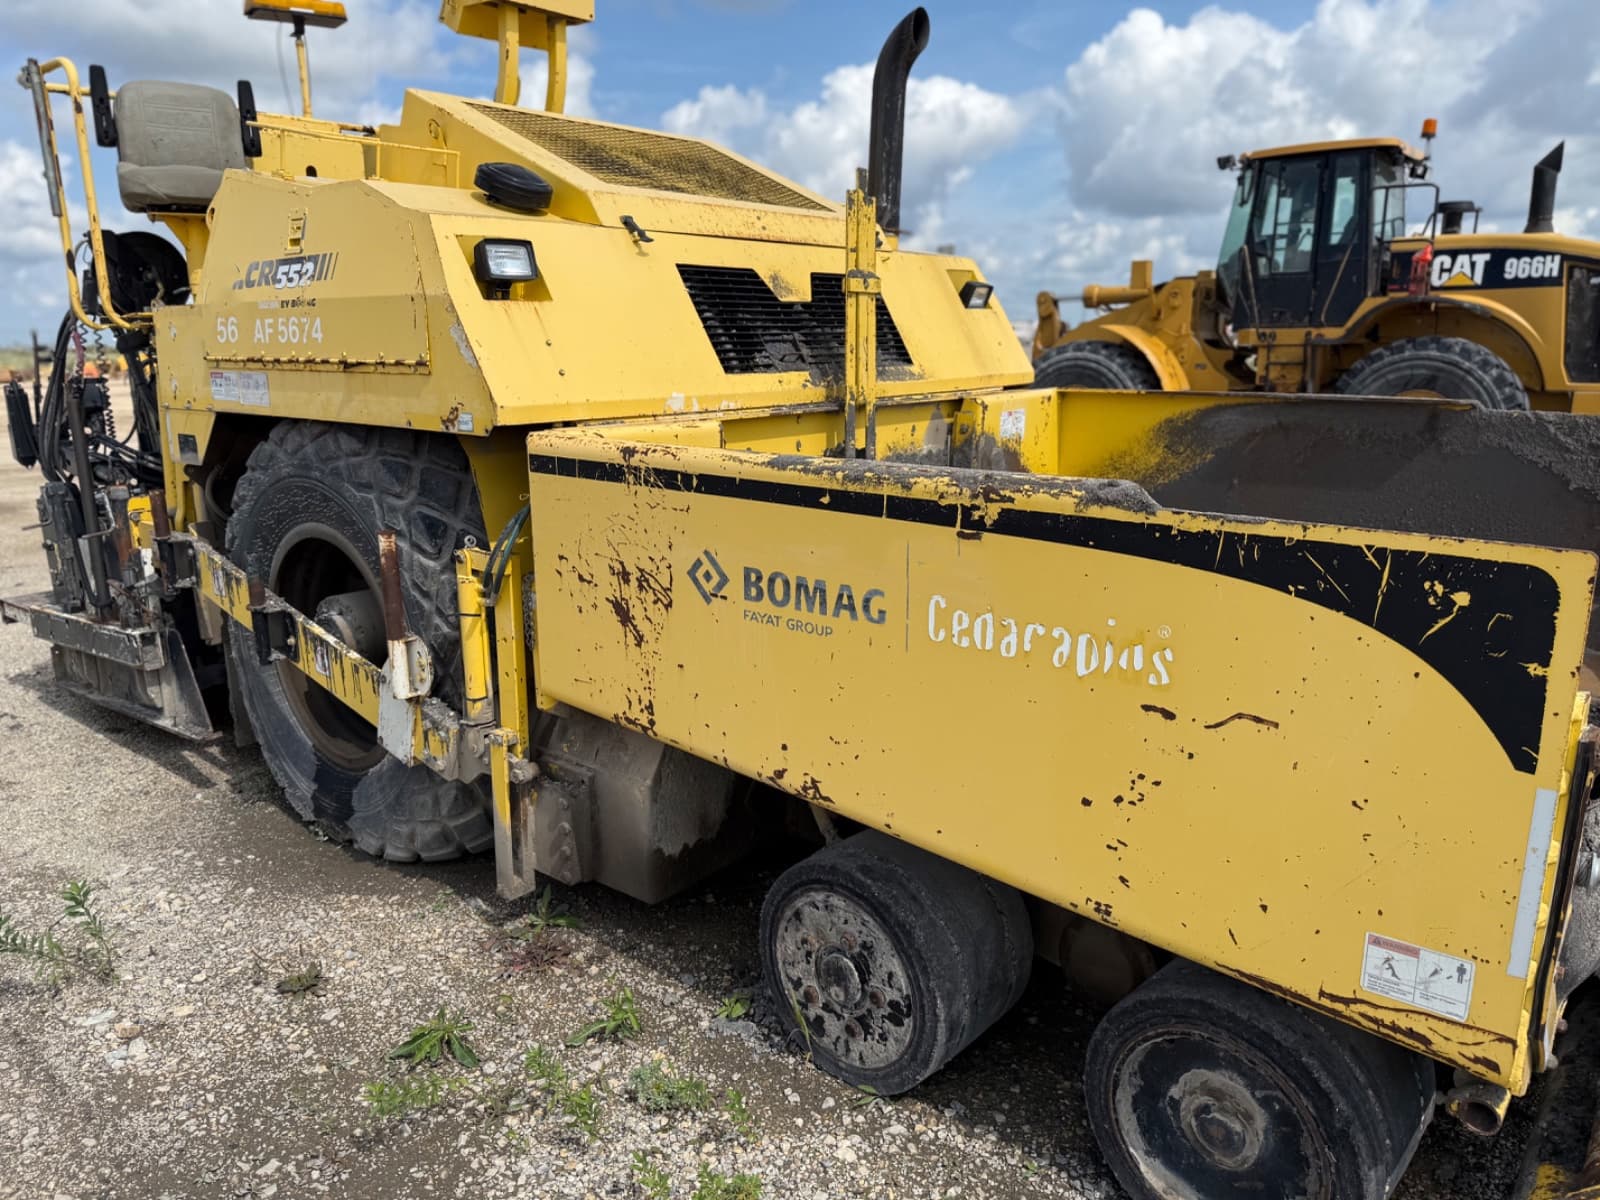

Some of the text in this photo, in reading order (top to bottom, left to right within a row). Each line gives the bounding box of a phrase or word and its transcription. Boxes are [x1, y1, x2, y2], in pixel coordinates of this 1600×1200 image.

[1431, 253, 1562, 288] CAT 966H
[216, 316, 324, 344] 56 AF 5674
[743, 566, 887, 625] BOMAG
[743, 609, 834, 637] FAYAT GROUP
